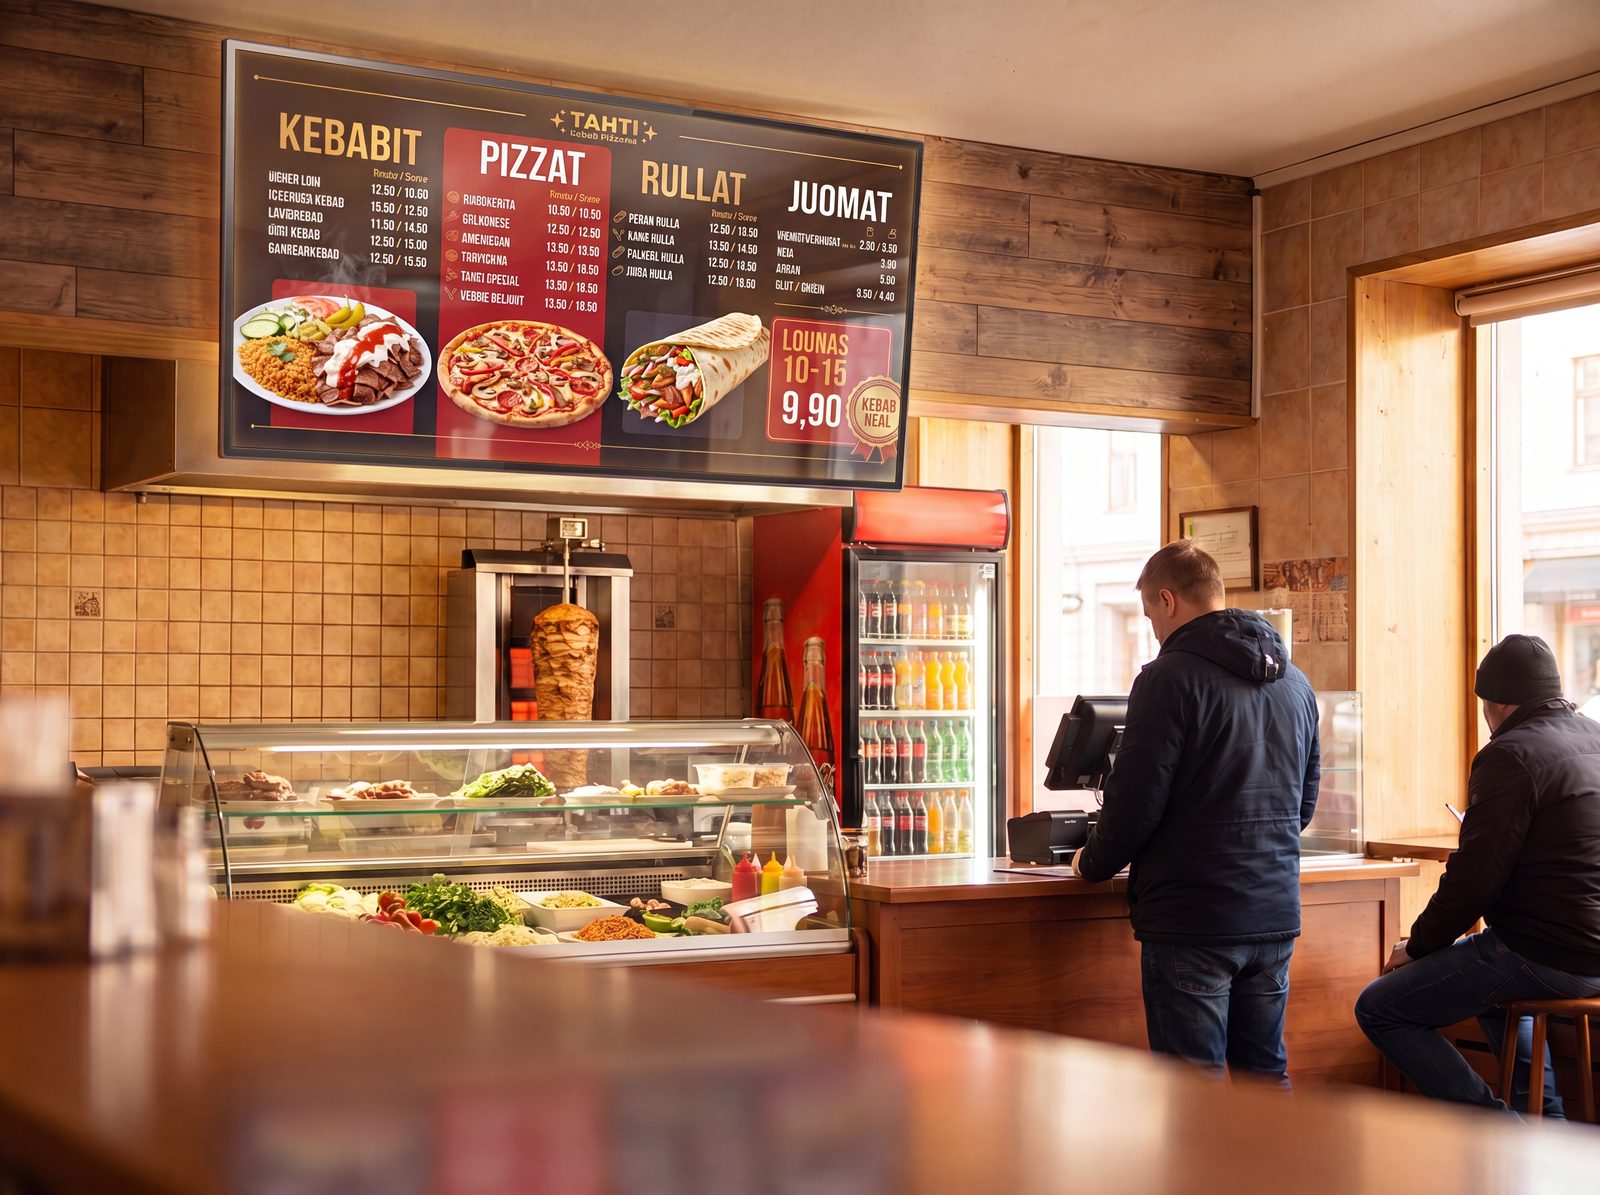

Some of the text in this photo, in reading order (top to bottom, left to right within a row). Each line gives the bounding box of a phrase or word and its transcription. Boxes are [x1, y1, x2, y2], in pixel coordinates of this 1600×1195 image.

[570, 111, 639, 136] TAHTI
[278, 112, 422, 166] KEBABIT
[480, 139, 586, 187] PIZZAT
[301, 174, 321, 188] LOIN
[641, 160, 747, 206] RULLAT
[371, 183, 395, 197] 12.50
[315, 194, 345, 208] KEBAB
[787, 180, 893, 223] JUOMAT
[371, 201, 395, 214] 15.50
[404, 204, 428, 217] 12.50
[547, 204, 570, 217] 10.50
[579, 207, 601, 220] 10.50
[370, 218, 395, 231] 11.50
[404, 221, 428, 234] 14.50
[628, 212, 654, 226] PERAN
[290, 226, 320, 241] KEBAB
[547, 223, 570, 235] 12.50
[578, 226, 601, 239] 12.50
[709, 223, 730, 235] 12.50
[370, 235, 395, 248] 12.50
[404, 238, 428, 251] 15.00
[546, 242, 569, 254] 13.50
[577, 245, 600, 257] 13.50
[708, 240, 730, 252] 13.50
[737, 243, 758, 255] 14.50
[881, 242, 898, 254] 3.50
[370, 252, 394, 265] 12.50
[404, 255, 427, 268] 15.50
[545, 260, 568, 272] 13.50
[708, 257, 729, 269] 12.50
[545, 279, 568, 291] 13.50
[707, 274, 728, 286] 12.50
[544, 297, 567, 309] 13.50
[782, 328, 850, 356] LOUNAS
[783, 354, 847, 387] 10-15
[782, 390, 842, 430] 9,90
[861, 397, 897, 413] KEBAB
[864, 413, 891, 428] NEAL
